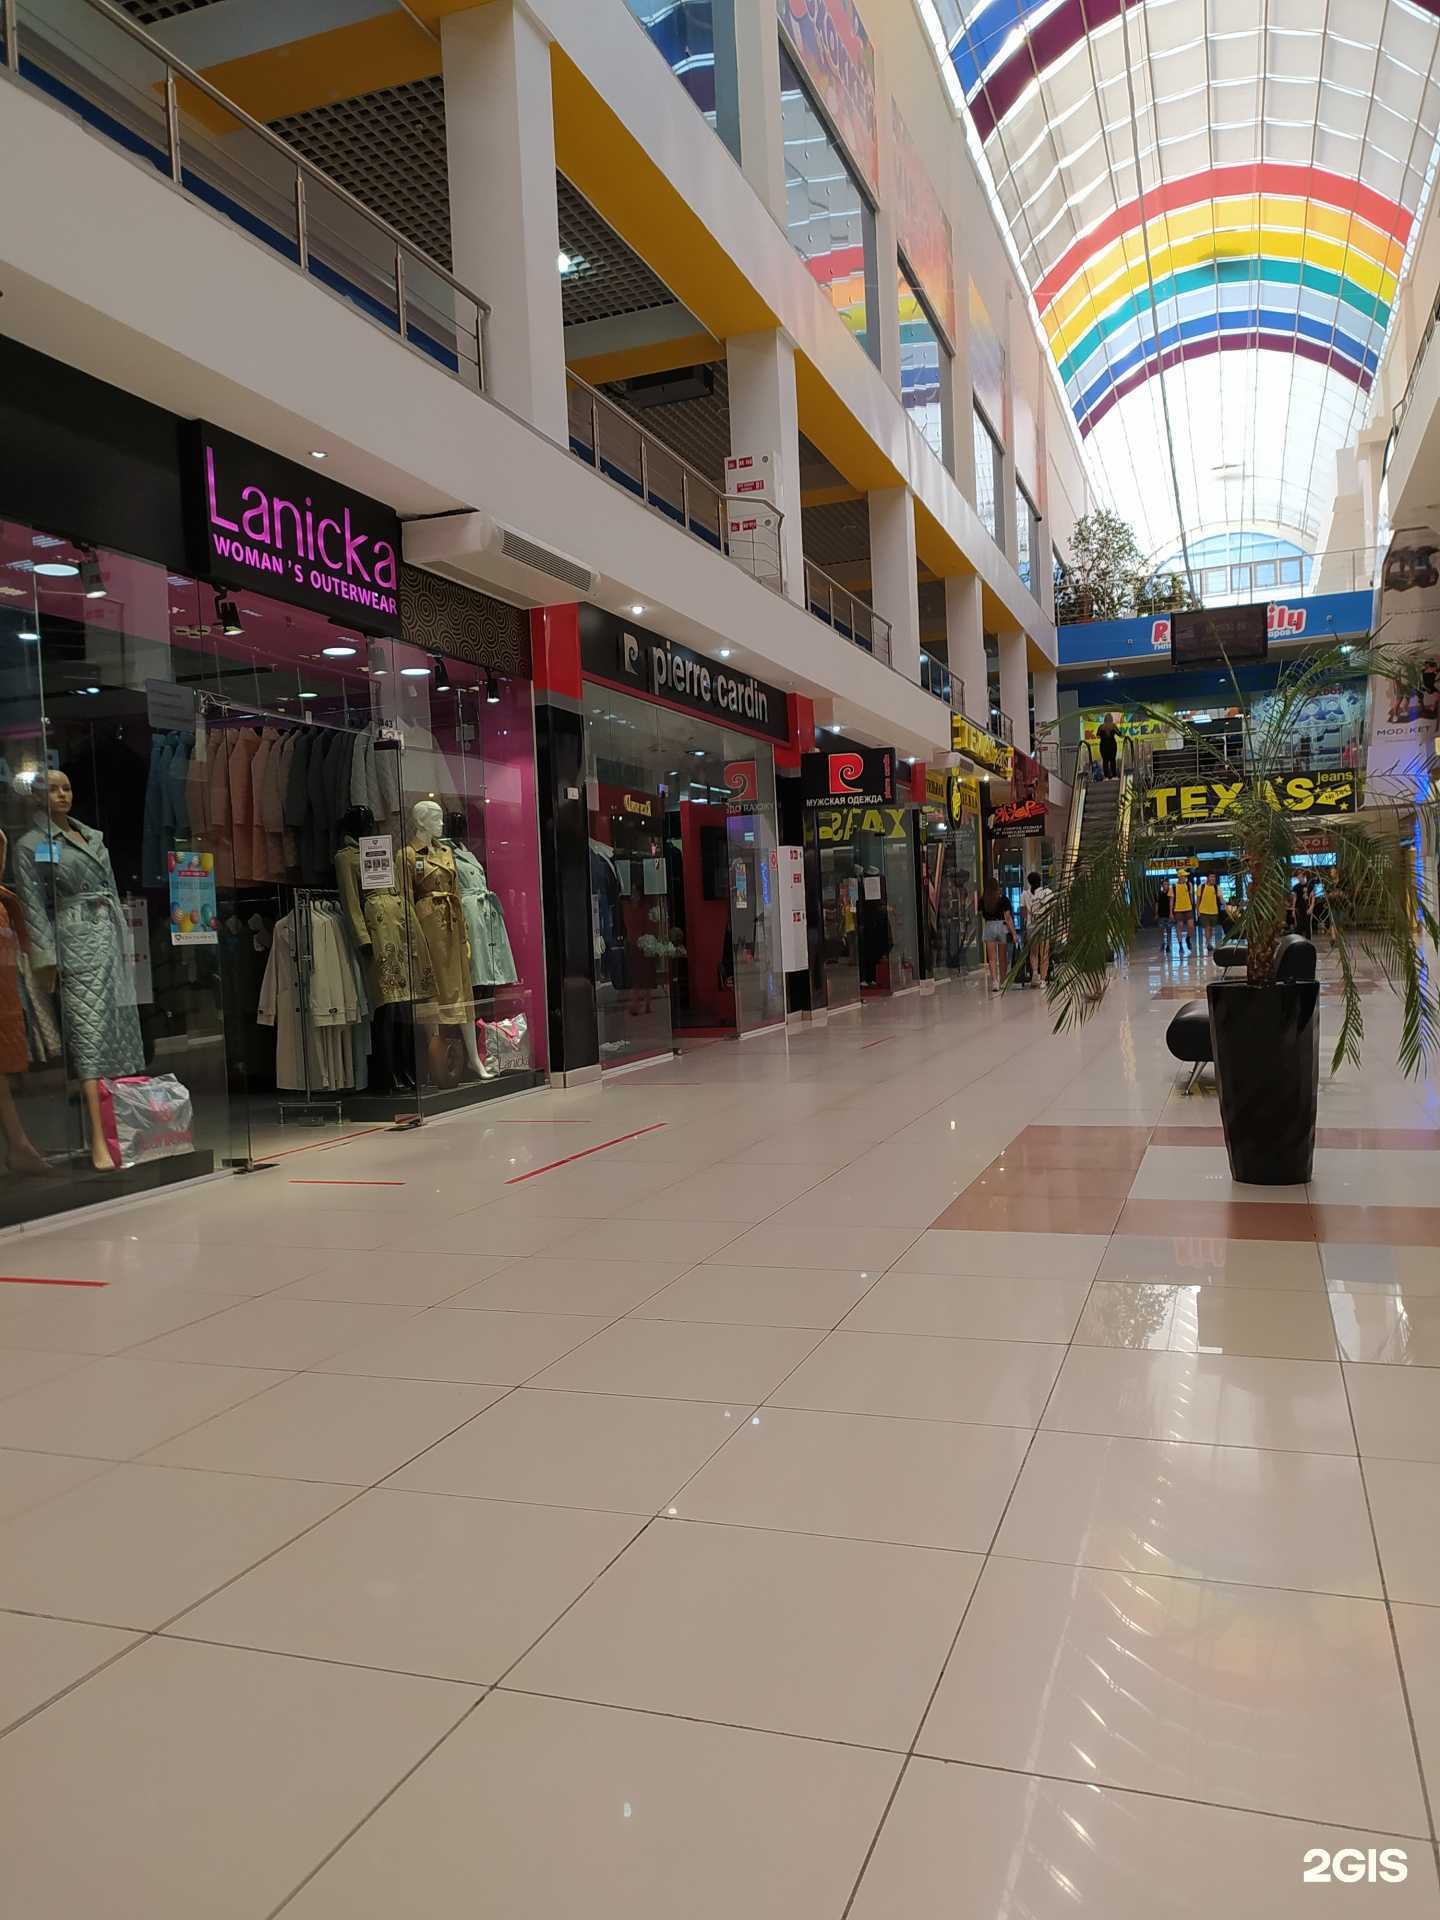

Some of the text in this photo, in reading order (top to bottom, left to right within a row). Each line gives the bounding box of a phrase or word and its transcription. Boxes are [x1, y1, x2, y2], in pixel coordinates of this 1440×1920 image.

[206, 446, 397, 591] Lanicka
[310, 569, 398, 615] OUTERWEAR
[1267, 606, 1305, 632] ily
[652, 640, 768, 723] pierre cardin
[1317, 771, 1353, 785] jeans
[806, 795, 883, 807] МУЖСКАЯ ОДЕЖДА
